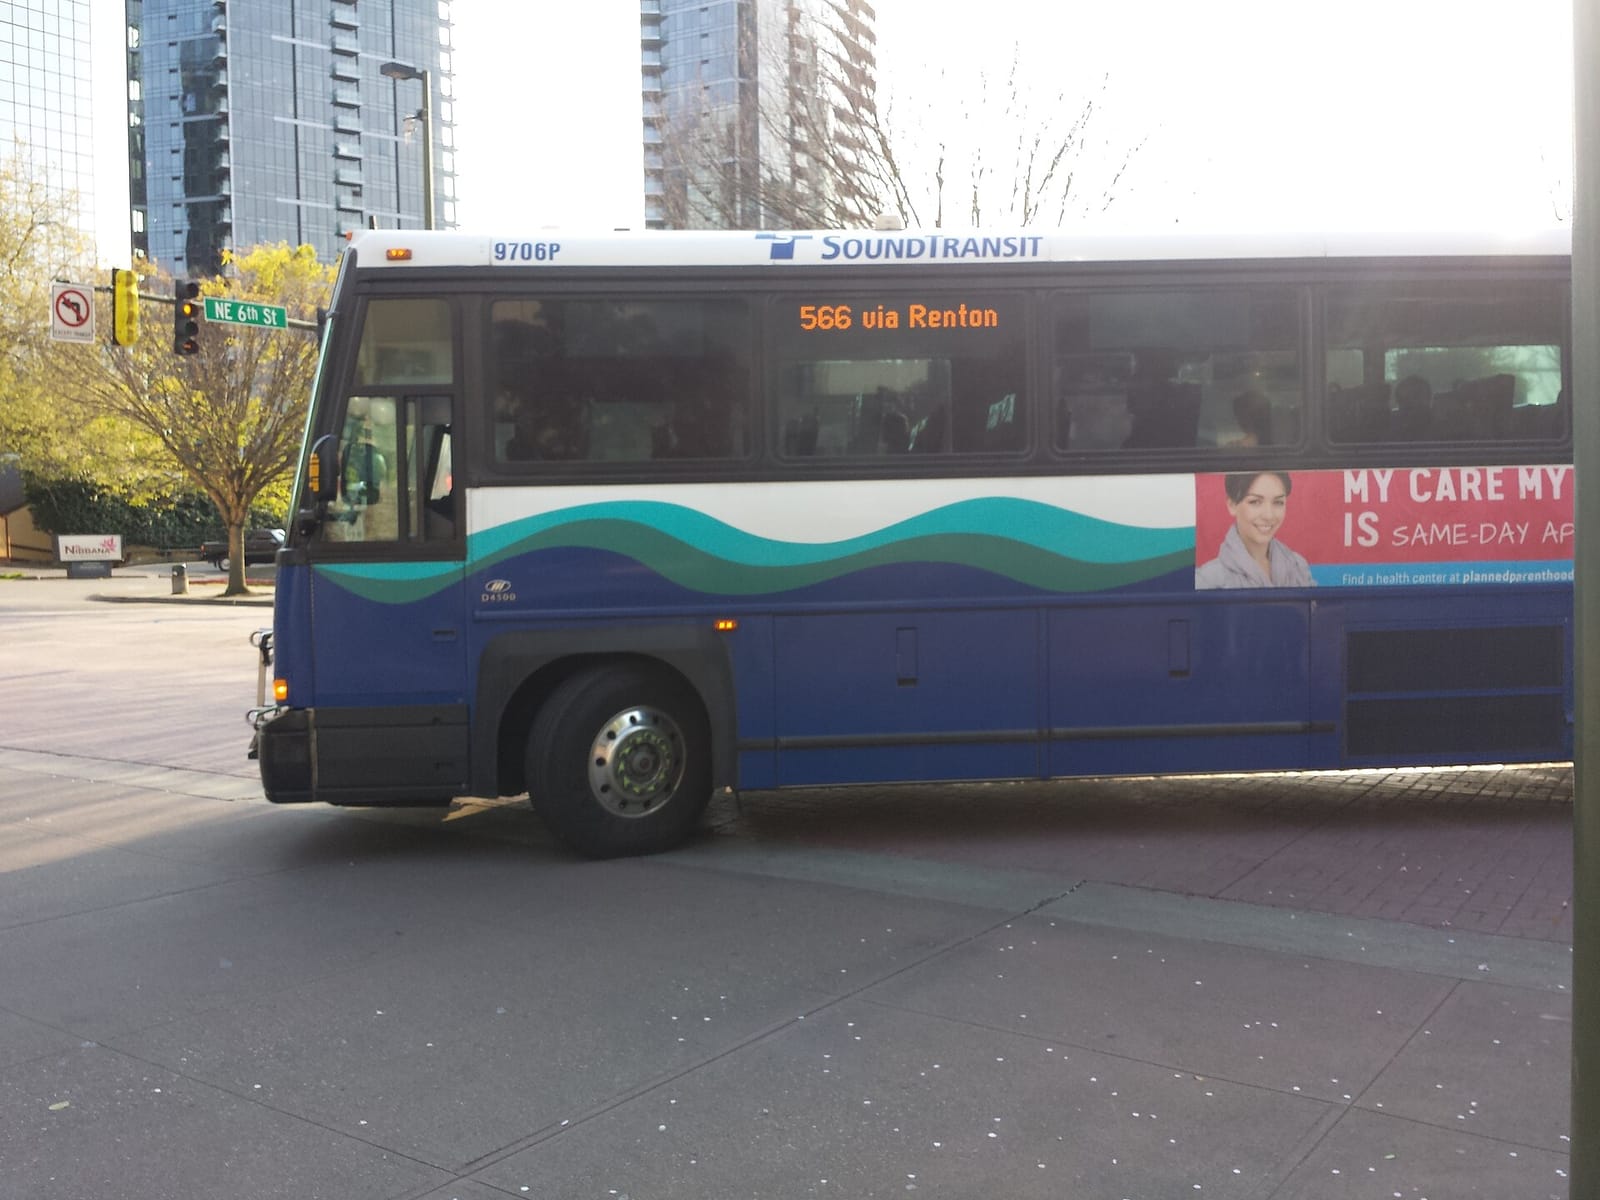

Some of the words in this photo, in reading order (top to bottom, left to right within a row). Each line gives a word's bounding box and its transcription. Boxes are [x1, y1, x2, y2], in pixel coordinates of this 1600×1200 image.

[494, 242, 561, 261] 9706P
[214, 301, 233, 320] NE
[237, 305, 259, 322] 6th
[262, 308, 278, 326] St
[800, 305, 852, 331] 566
[861, 304, 899, 330] via
[908, 303, 999, 329] Renton
[1343, 469, 1394, 504] MY
[1409, 467, 1505, 503] CARE
[1517, 467, 1568, 501] MY
[1343, 511, 1380, 548] IS
[1391, 521, 1529, 547] SAME-DAY
[1342, 573, 1364, 585] Find
[1367, 576, 1374, 585] a
[1376, 571, 1410, 584] health
[1412, 571, 1448, 583] center
[1449, 571, 1461, 583] at
[1462, 569, 1575, 584] plannedparenthood
